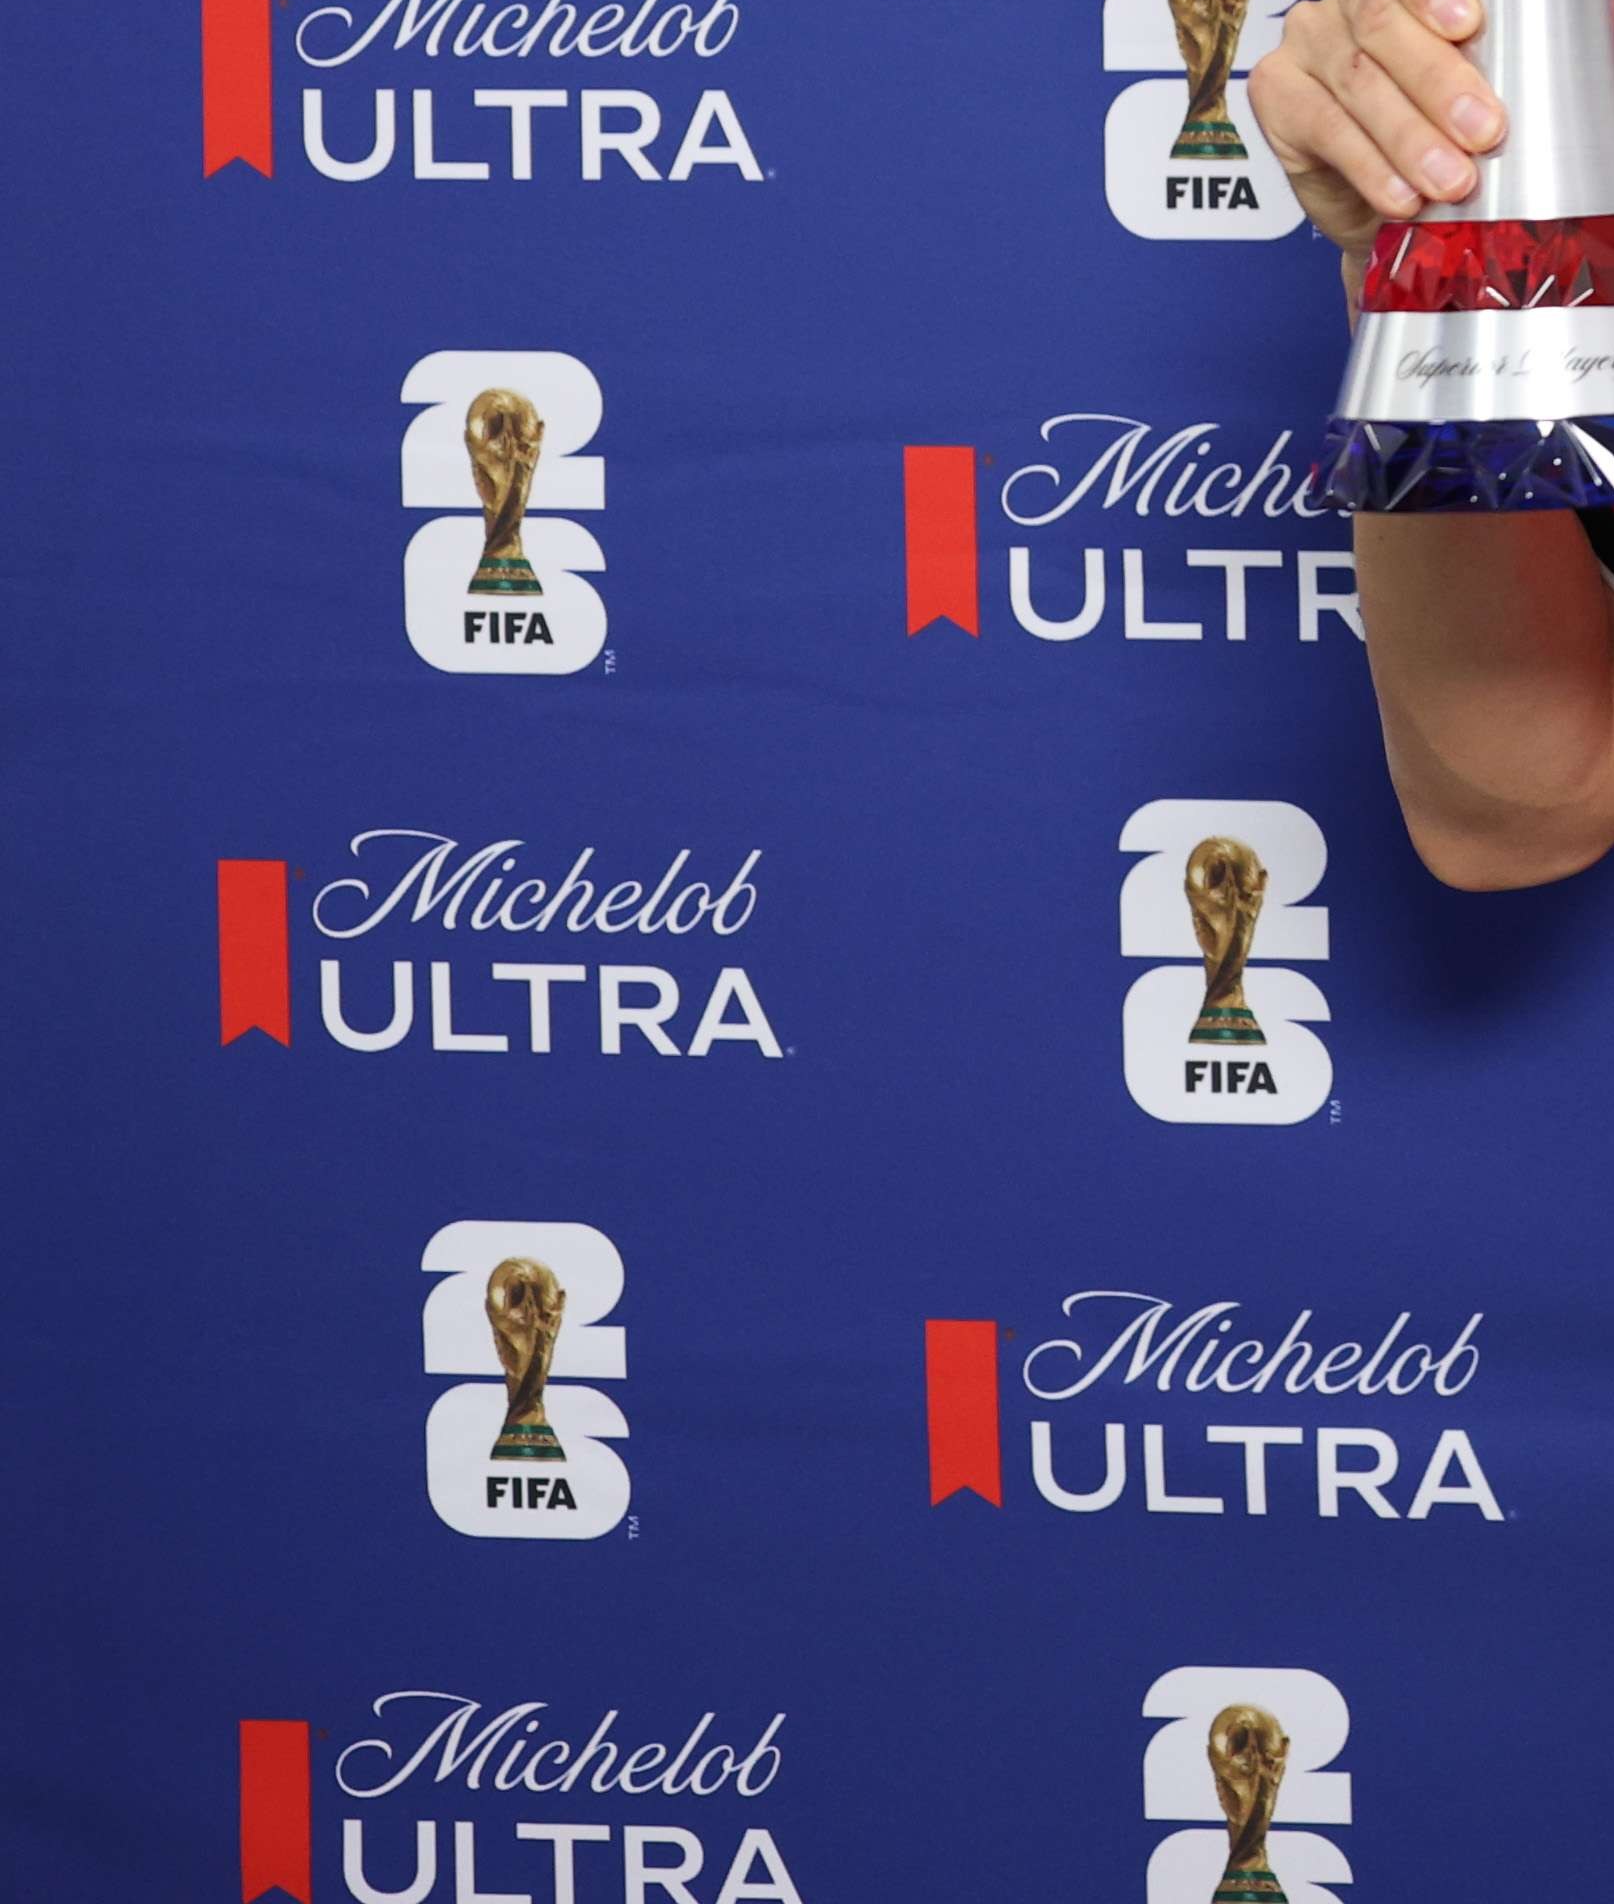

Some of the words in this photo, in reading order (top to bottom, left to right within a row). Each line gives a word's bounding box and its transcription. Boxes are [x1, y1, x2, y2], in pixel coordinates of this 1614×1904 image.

[303, 89, 764, 181] ULTRA
[1166, 176, 1260, 210] FIFA
[464, 611, 554, 645] FIFA
[313, 829, 762, 938] Michelob
[321, 960, 783, 1058] ULTRA
[1185, 1060, 1278, 1095] FIFA
[1023, 1291, 1483, 1400] Michelob
[486, 1476, 577, 1510] FIFA
[1031, 1421, 1504, 1521] ULTRA
[336, 1691, 786, 1797] Michelob
[343, 1819, 802, 1904] ULTRA
